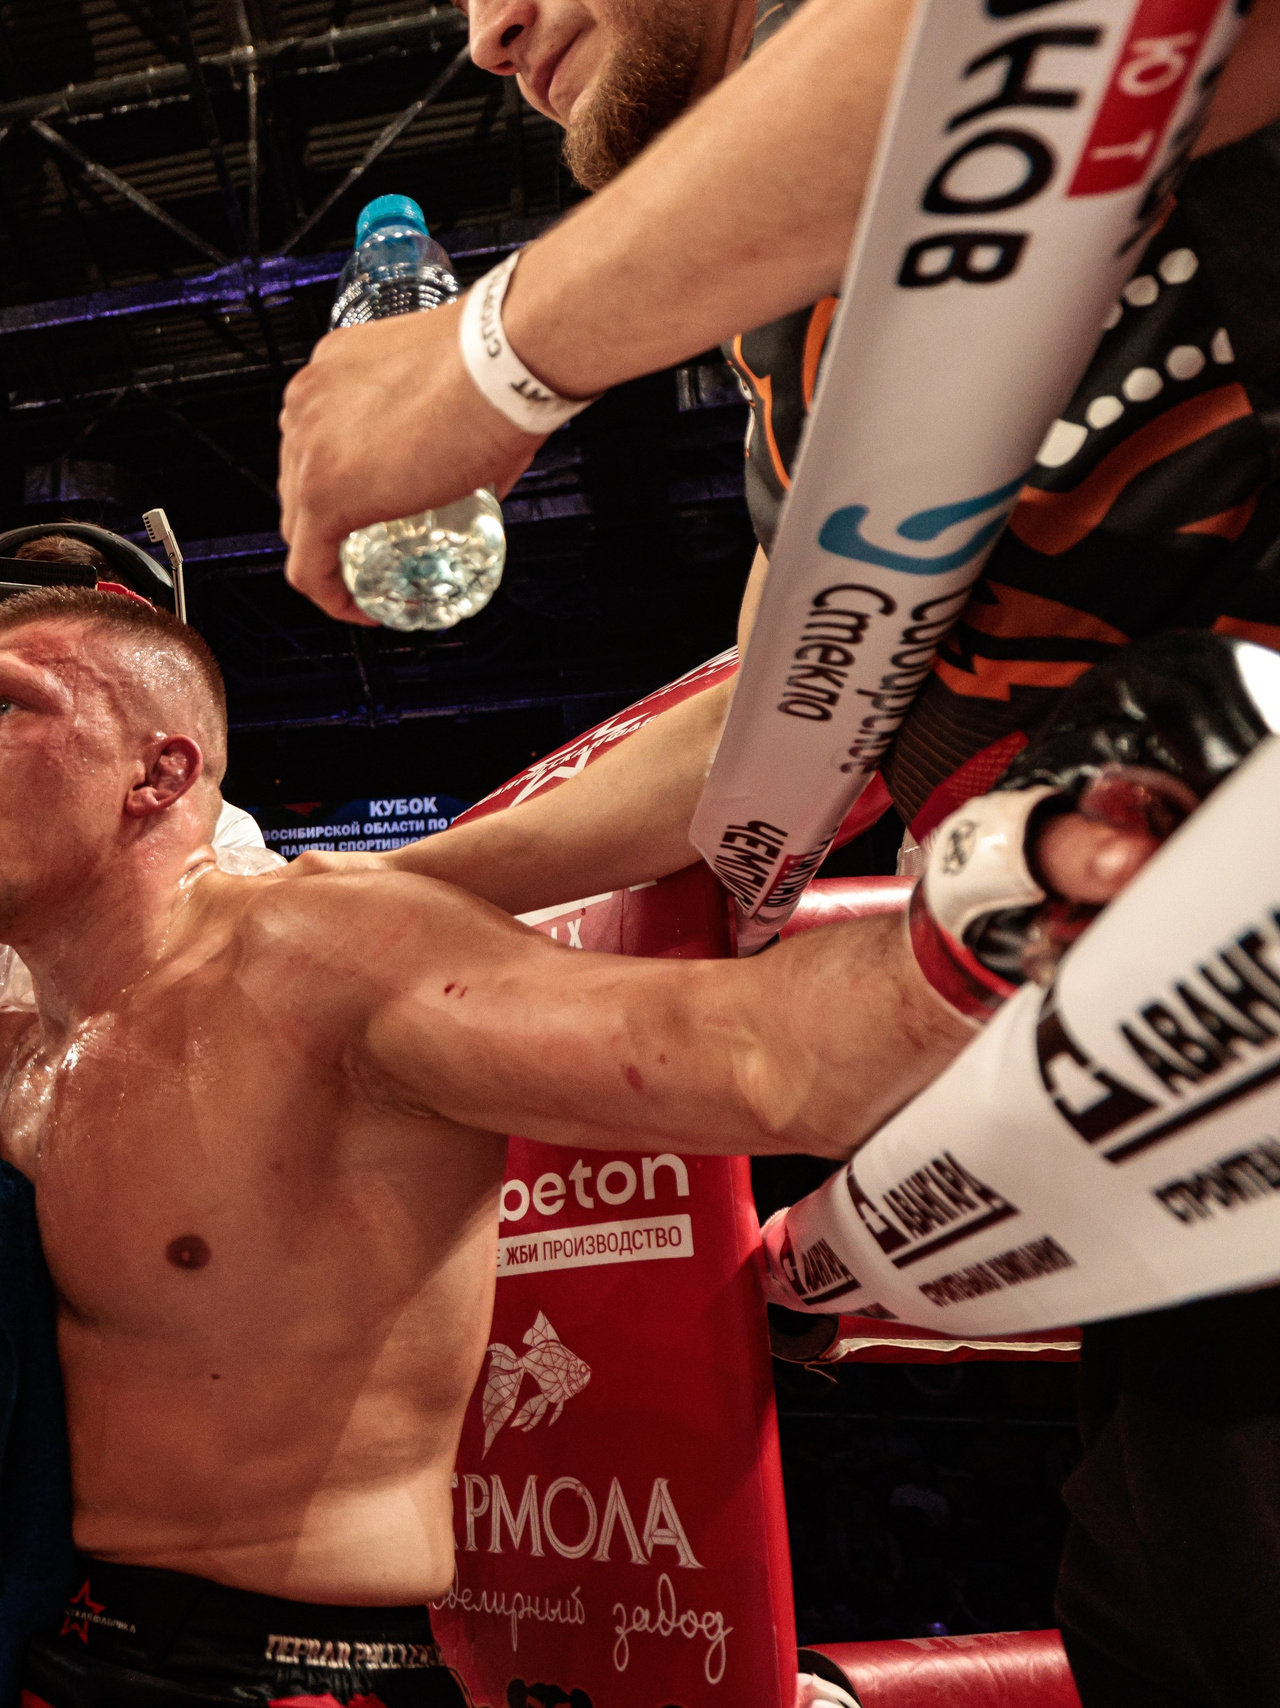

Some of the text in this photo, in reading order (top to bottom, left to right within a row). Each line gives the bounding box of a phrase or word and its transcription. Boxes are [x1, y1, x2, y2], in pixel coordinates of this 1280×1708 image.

[894, 0, 1103, 289] НОВ
[369, 797, 439, 818] КУБОК
[263, 817, 448, 841] ВОСИБИРСКОЙ ОБЛАСТИ ПО
[281, 841, 336, 856] ПАМЯТИ
[1118, 906, 1280, 1096] АВАНГ
[506, 1243, 539, 1267] ЖБИ
[543, 1225, 682, 1261] ПРОИЗВОДСТВО
[452, 1472, 705, 1569] РМОЛА
